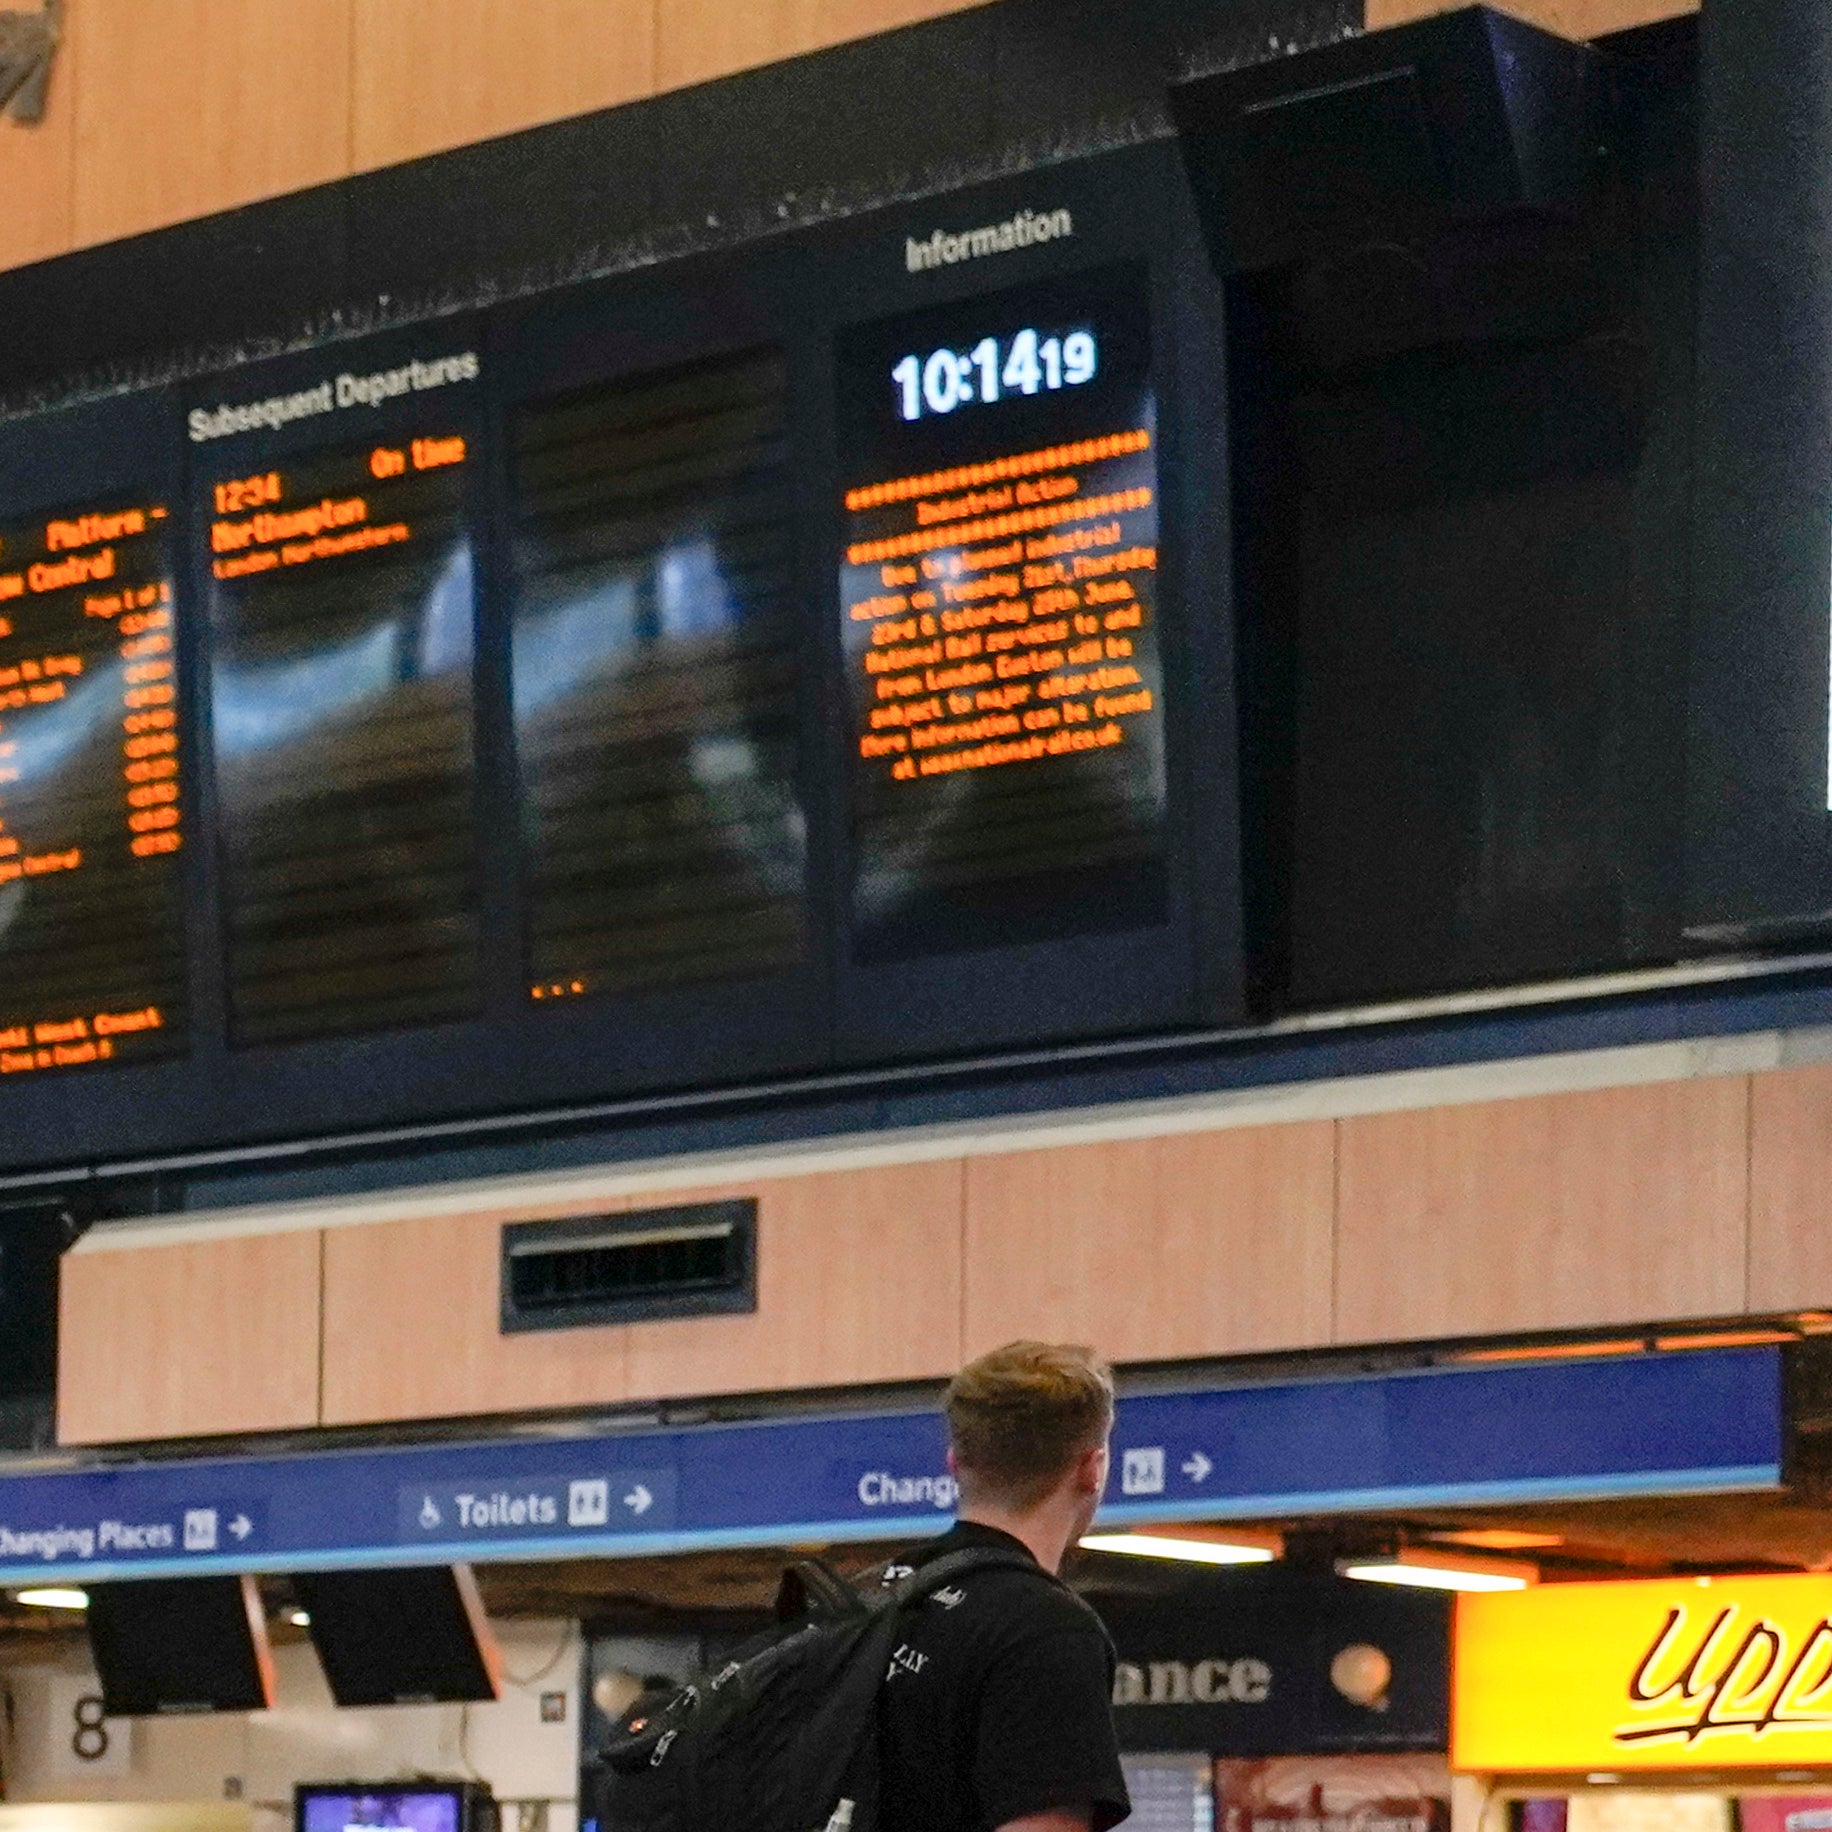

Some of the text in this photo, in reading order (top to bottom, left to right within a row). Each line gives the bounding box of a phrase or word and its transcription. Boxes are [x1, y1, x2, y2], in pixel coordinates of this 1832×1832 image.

[906, 208, 1073, 272] Information
[188, 352, 480, 442] Subsequent Departures
[212, 497, 366, 552] Northampton
[454, 1488, 558, 1529] Toilets
[858, 1471, 960, 1509] Chang
[98, 1516, 176, 1552] Places
[72, 1696, 110, 1761] 8
